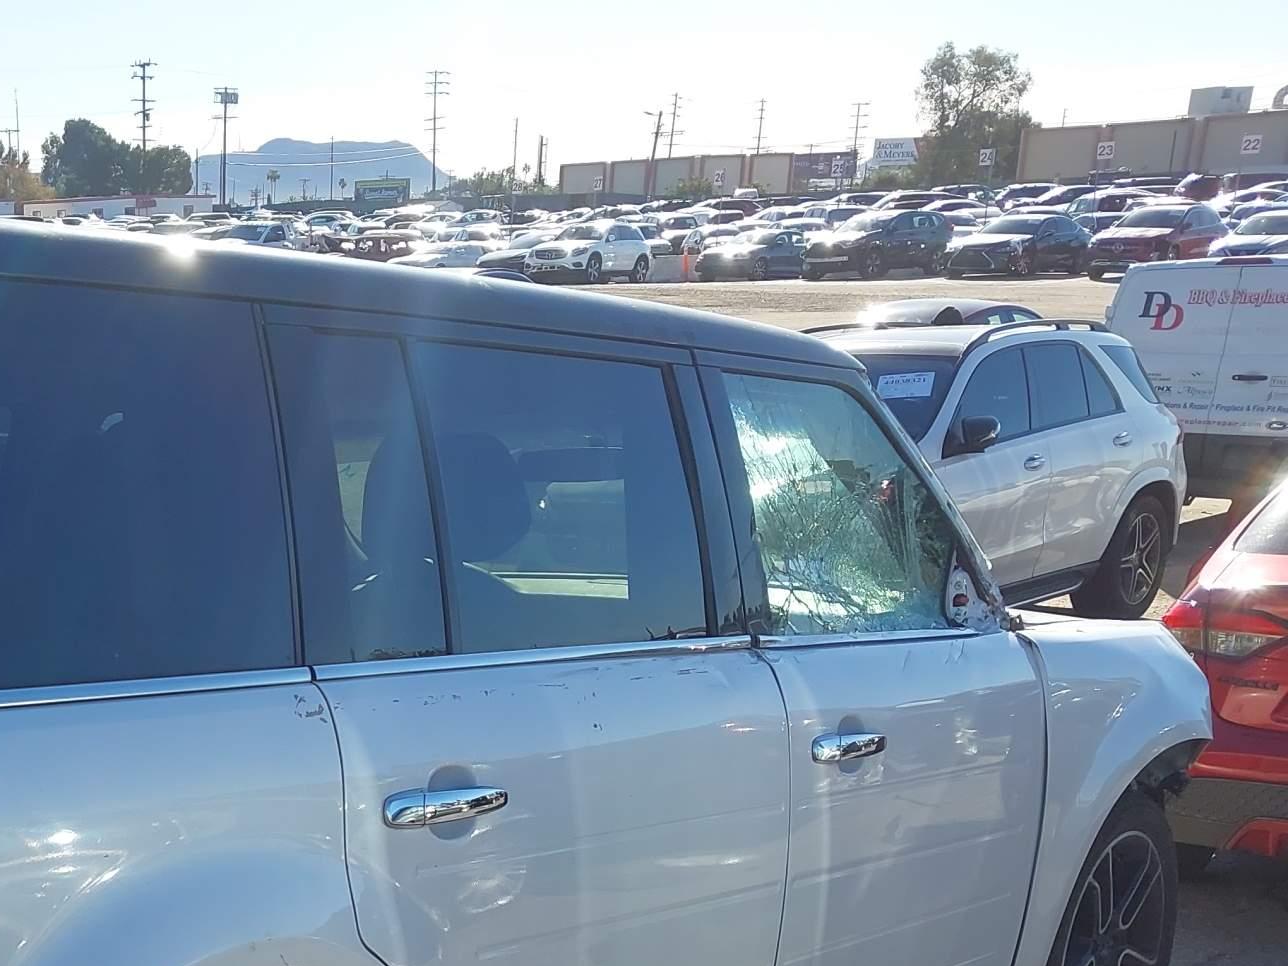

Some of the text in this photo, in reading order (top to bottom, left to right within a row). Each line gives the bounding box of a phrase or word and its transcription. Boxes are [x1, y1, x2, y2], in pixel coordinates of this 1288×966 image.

[1098, 144, 1113, 156] 23
[1242, 138, 1259, 151] 22
[980, 152, 992, 163] 24
[594, 179, 603, 188] 27
[715, 173, 725, 183] 26
[513, 183, 523, 191] 28
[1187, 288, 1217, 306] BBQ
[1218, 289, 1230, 304] &
